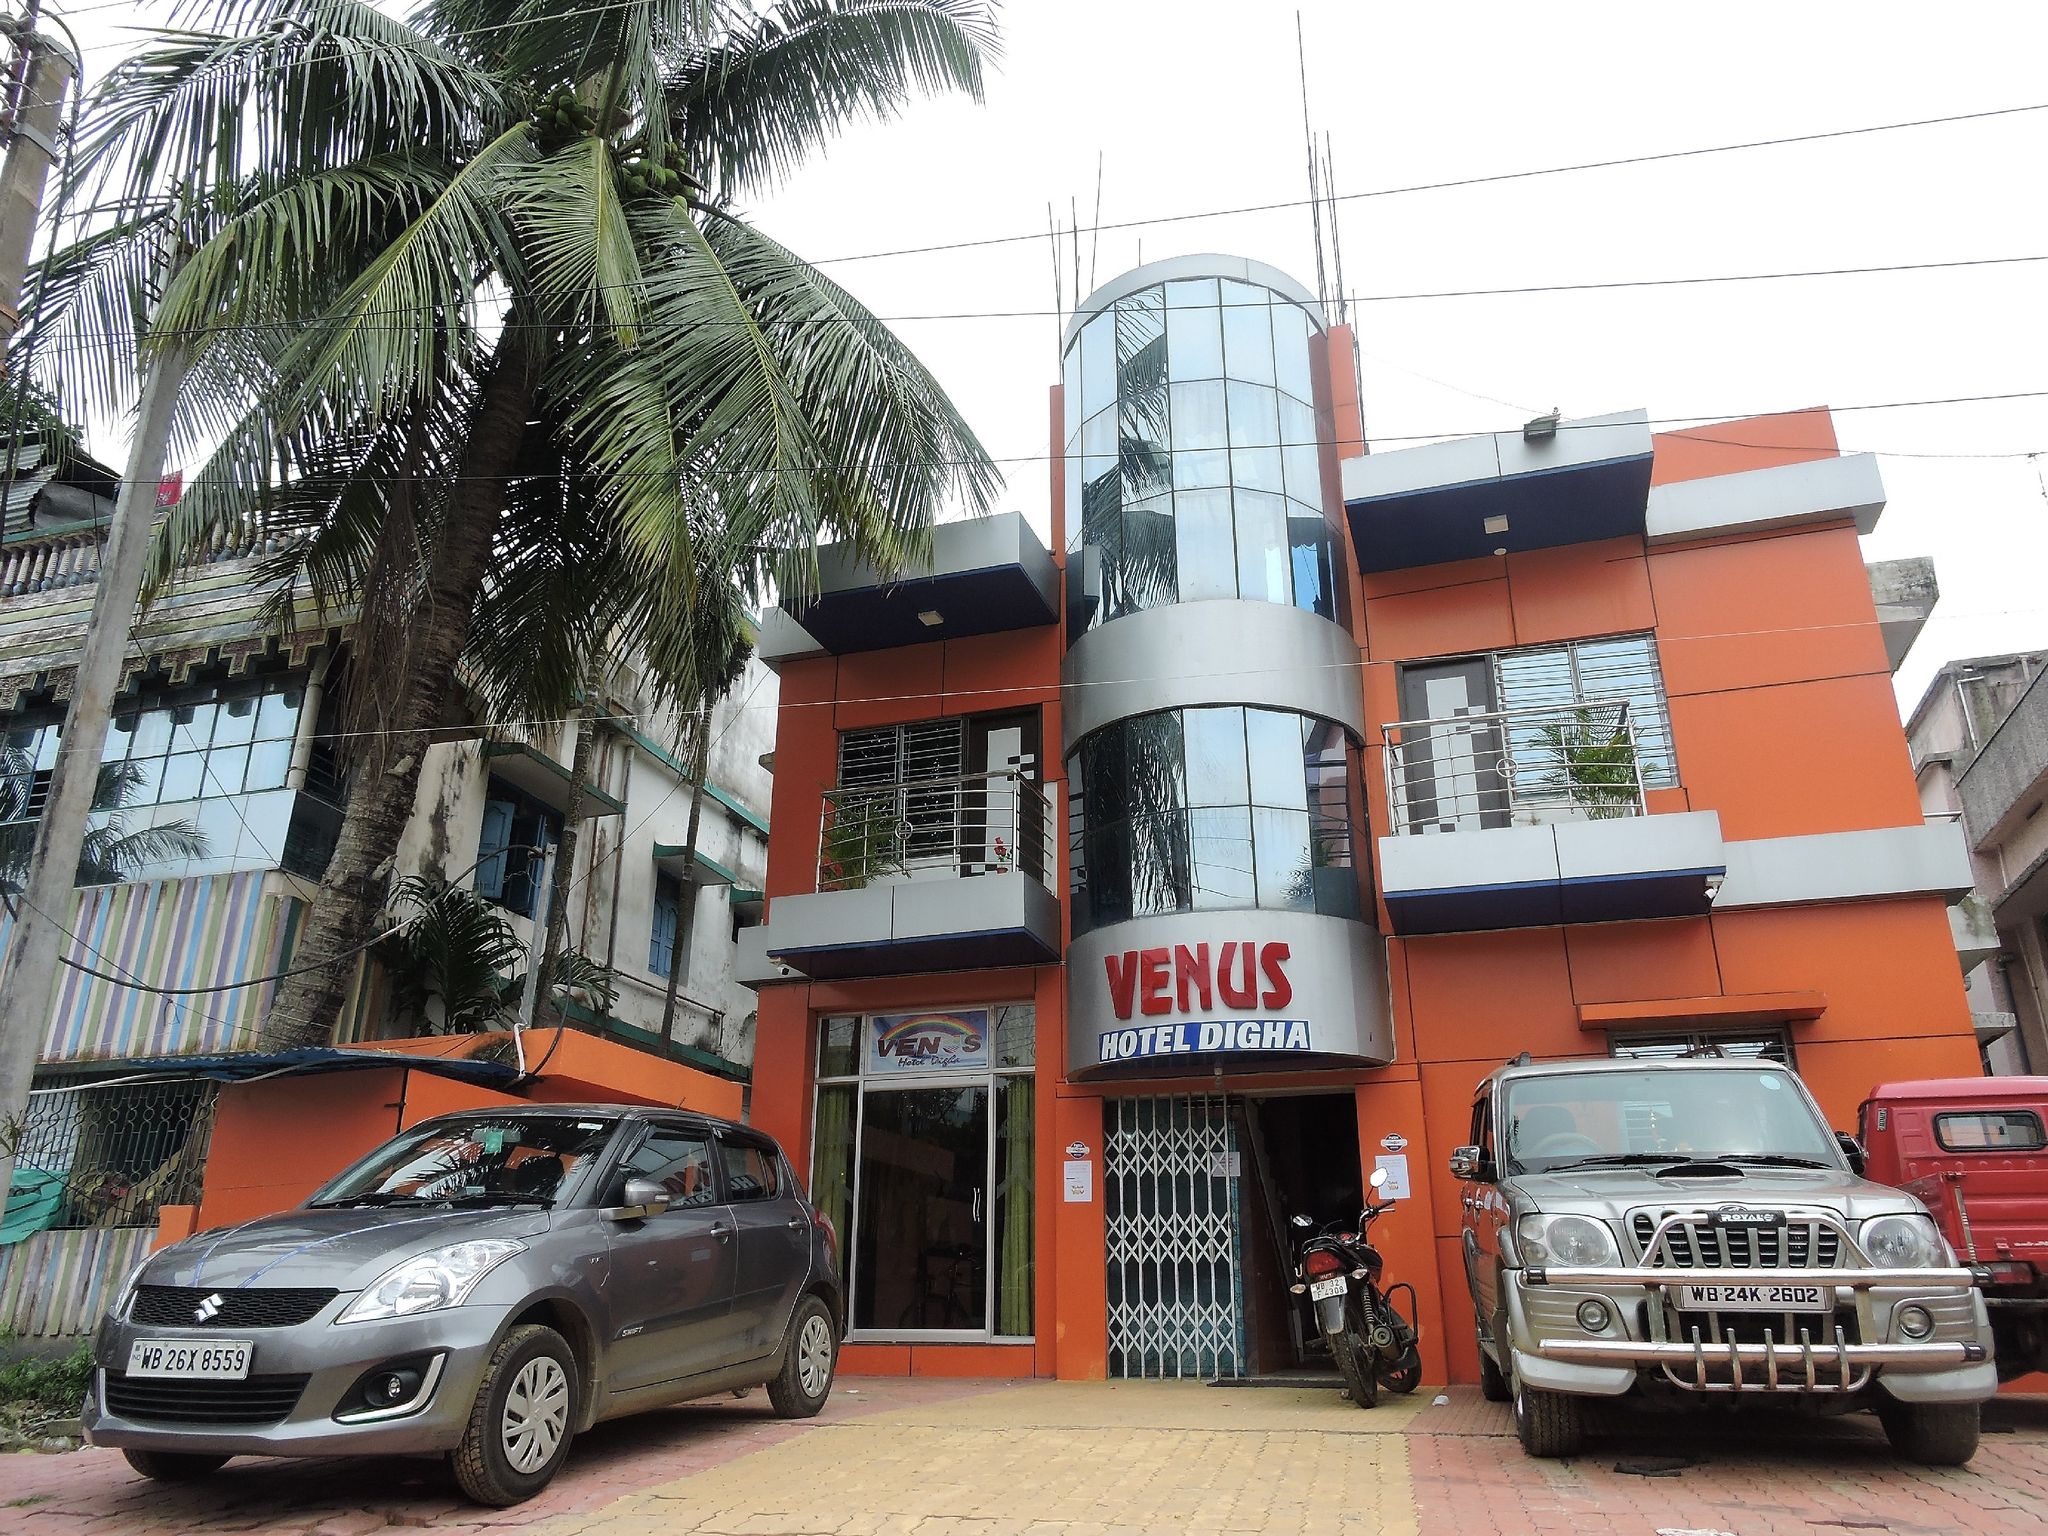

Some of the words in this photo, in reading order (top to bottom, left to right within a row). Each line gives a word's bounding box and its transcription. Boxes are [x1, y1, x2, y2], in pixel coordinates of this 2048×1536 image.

[1104, 941, 1293, 1019] VENUS
[1101, 1025, 1190, 1061] HOTEL
[1198, 1021, 1310, 1051] DIGHA
[898, 1057, 925, 1067] Hotel
[931, 1055, 961, 1068] Digha
[1315, 1283, 1325, 1291] WB
[141, 1347, 162, 1370] WB
[165, 1349, 199, 1371] 26X
[201, 1349, 245, 1371] 8559
